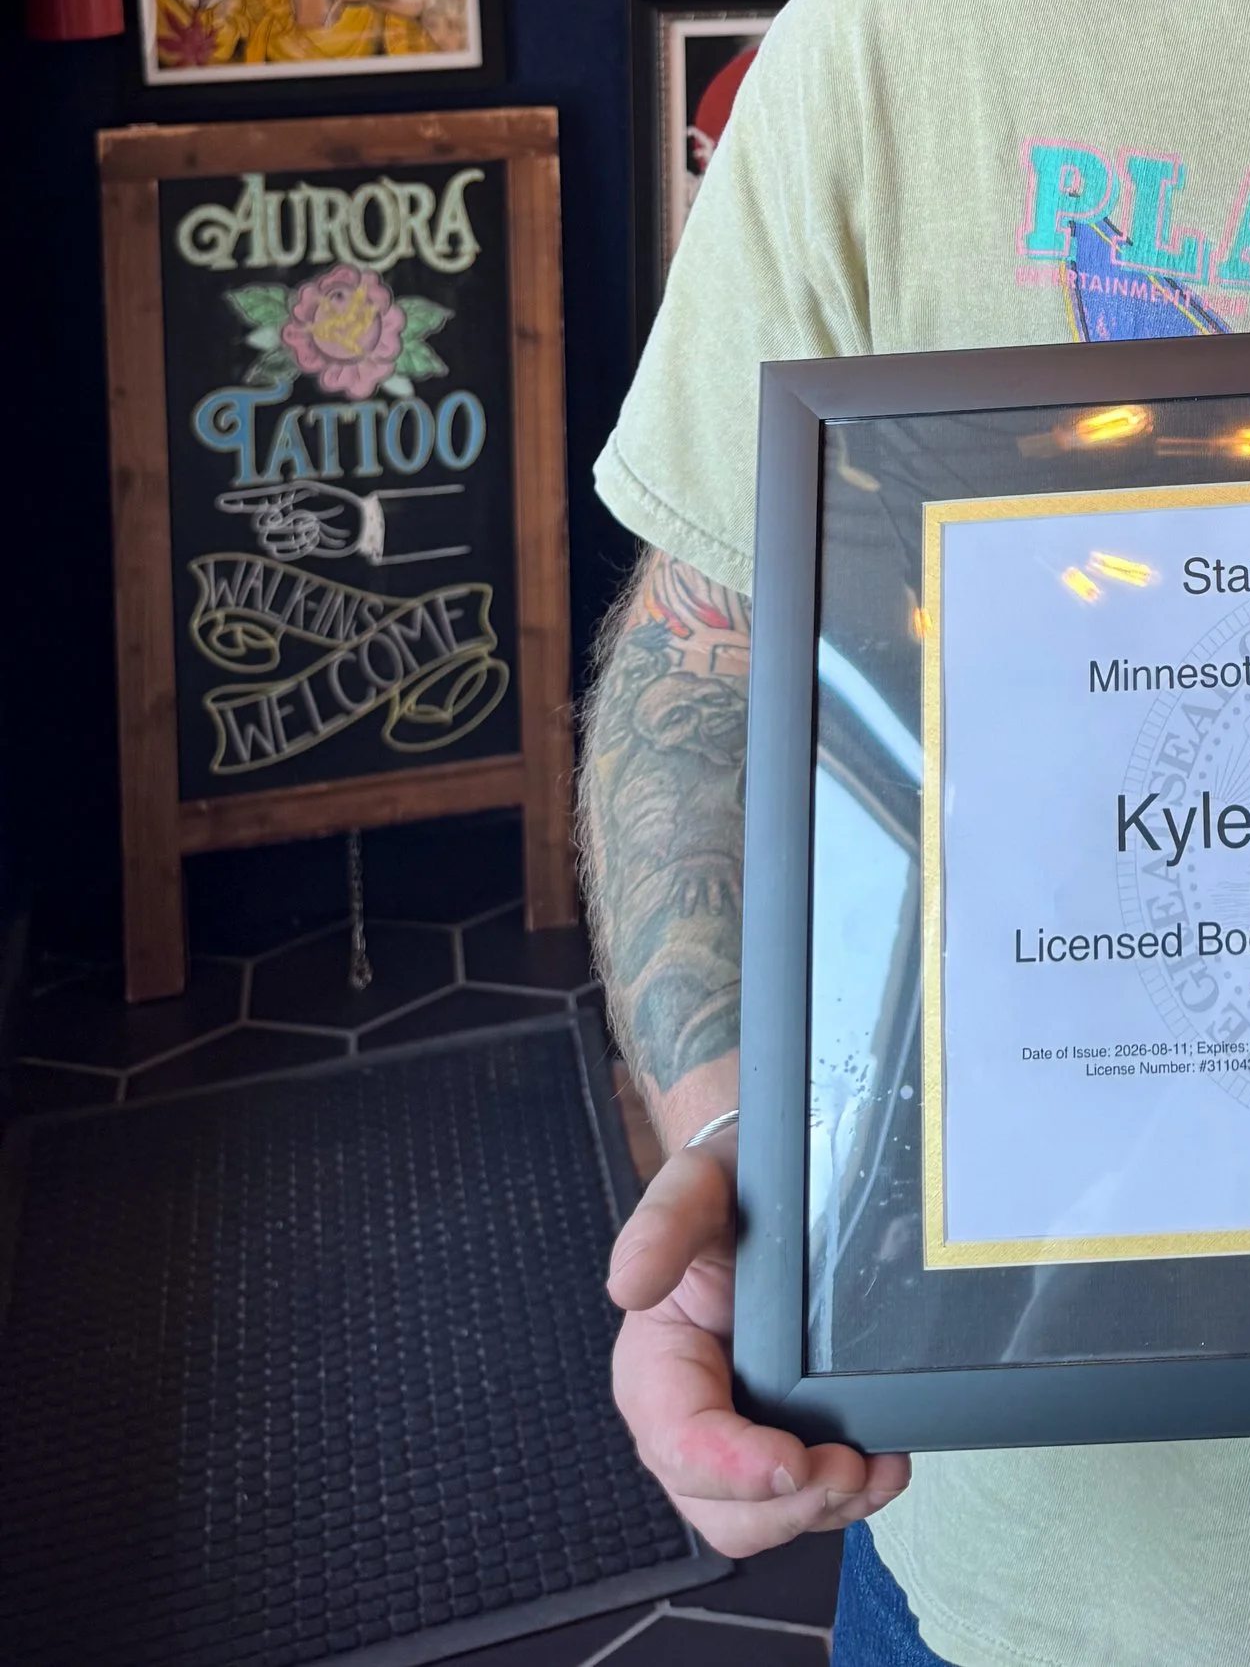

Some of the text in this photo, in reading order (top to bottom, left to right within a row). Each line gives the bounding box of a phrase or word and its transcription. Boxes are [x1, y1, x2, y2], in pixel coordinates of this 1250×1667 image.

[176, 168, 485, 273] AURORA
[194, 378, 487, 487] TATTOO
[222, 586, 476, 764] WELCOME
[1015, 922, 1183, 963] Licensed
[1022, 1046, 1052, 1060] Date
[1056, 1044, 1069, 1059] of
[1072, 1042, 1111, 1059] Issue:
[1114, 1041, 1193, 1058] 2026-08-11;
[1197, 1039, 1249, 1057] Expires:
[1086, 1061, 1136, 1076] License
[1139, 1058, 1196, 1075] Number:
